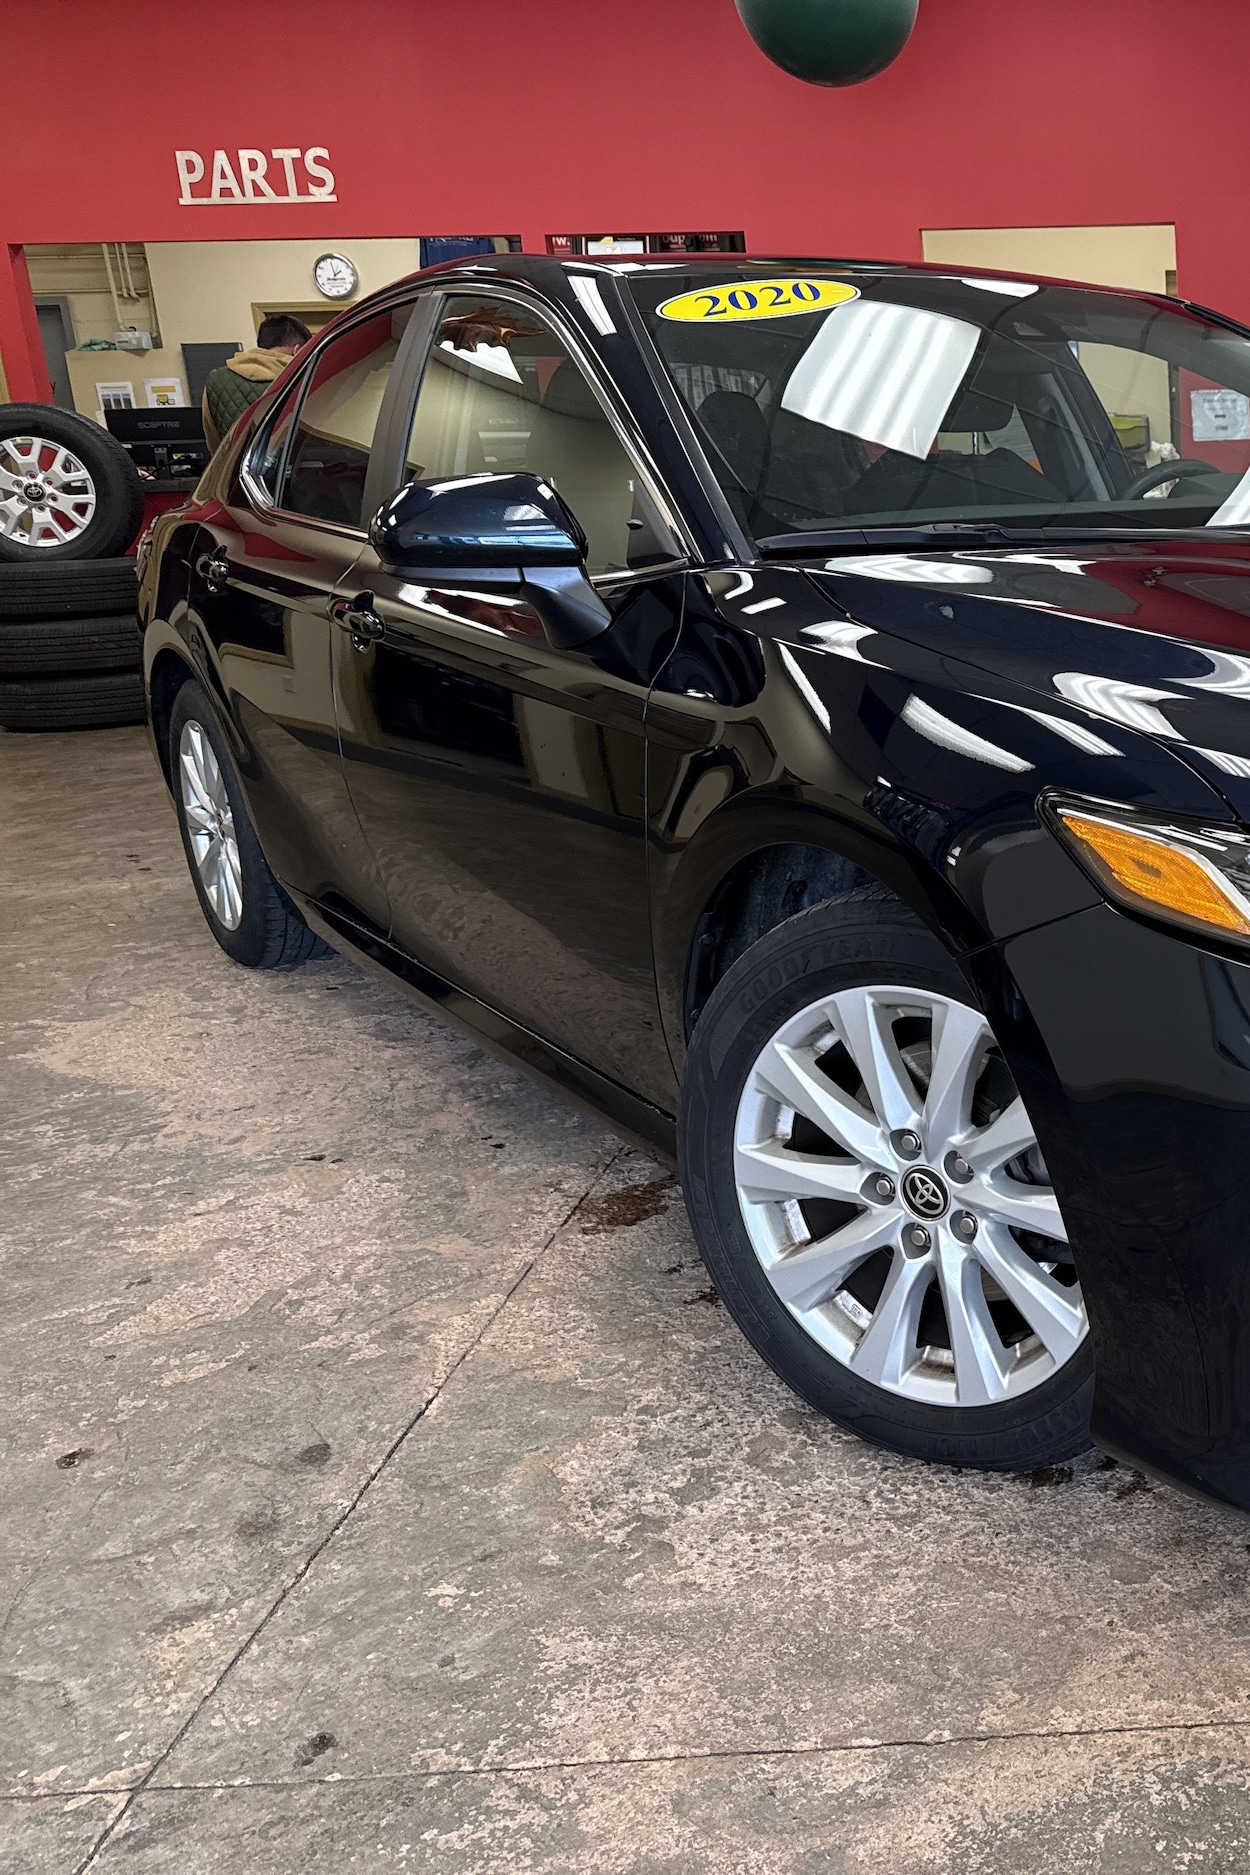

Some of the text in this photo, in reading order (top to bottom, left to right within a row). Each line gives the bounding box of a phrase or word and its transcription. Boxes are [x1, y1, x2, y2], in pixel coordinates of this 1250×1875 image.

[175, 146, 336, 201] PARTS
[695, 283, 820, 317] 2020
[137, 421, 180, 429] SCEPTRE
[739, 936, 896, 1015] GOODYEAR
